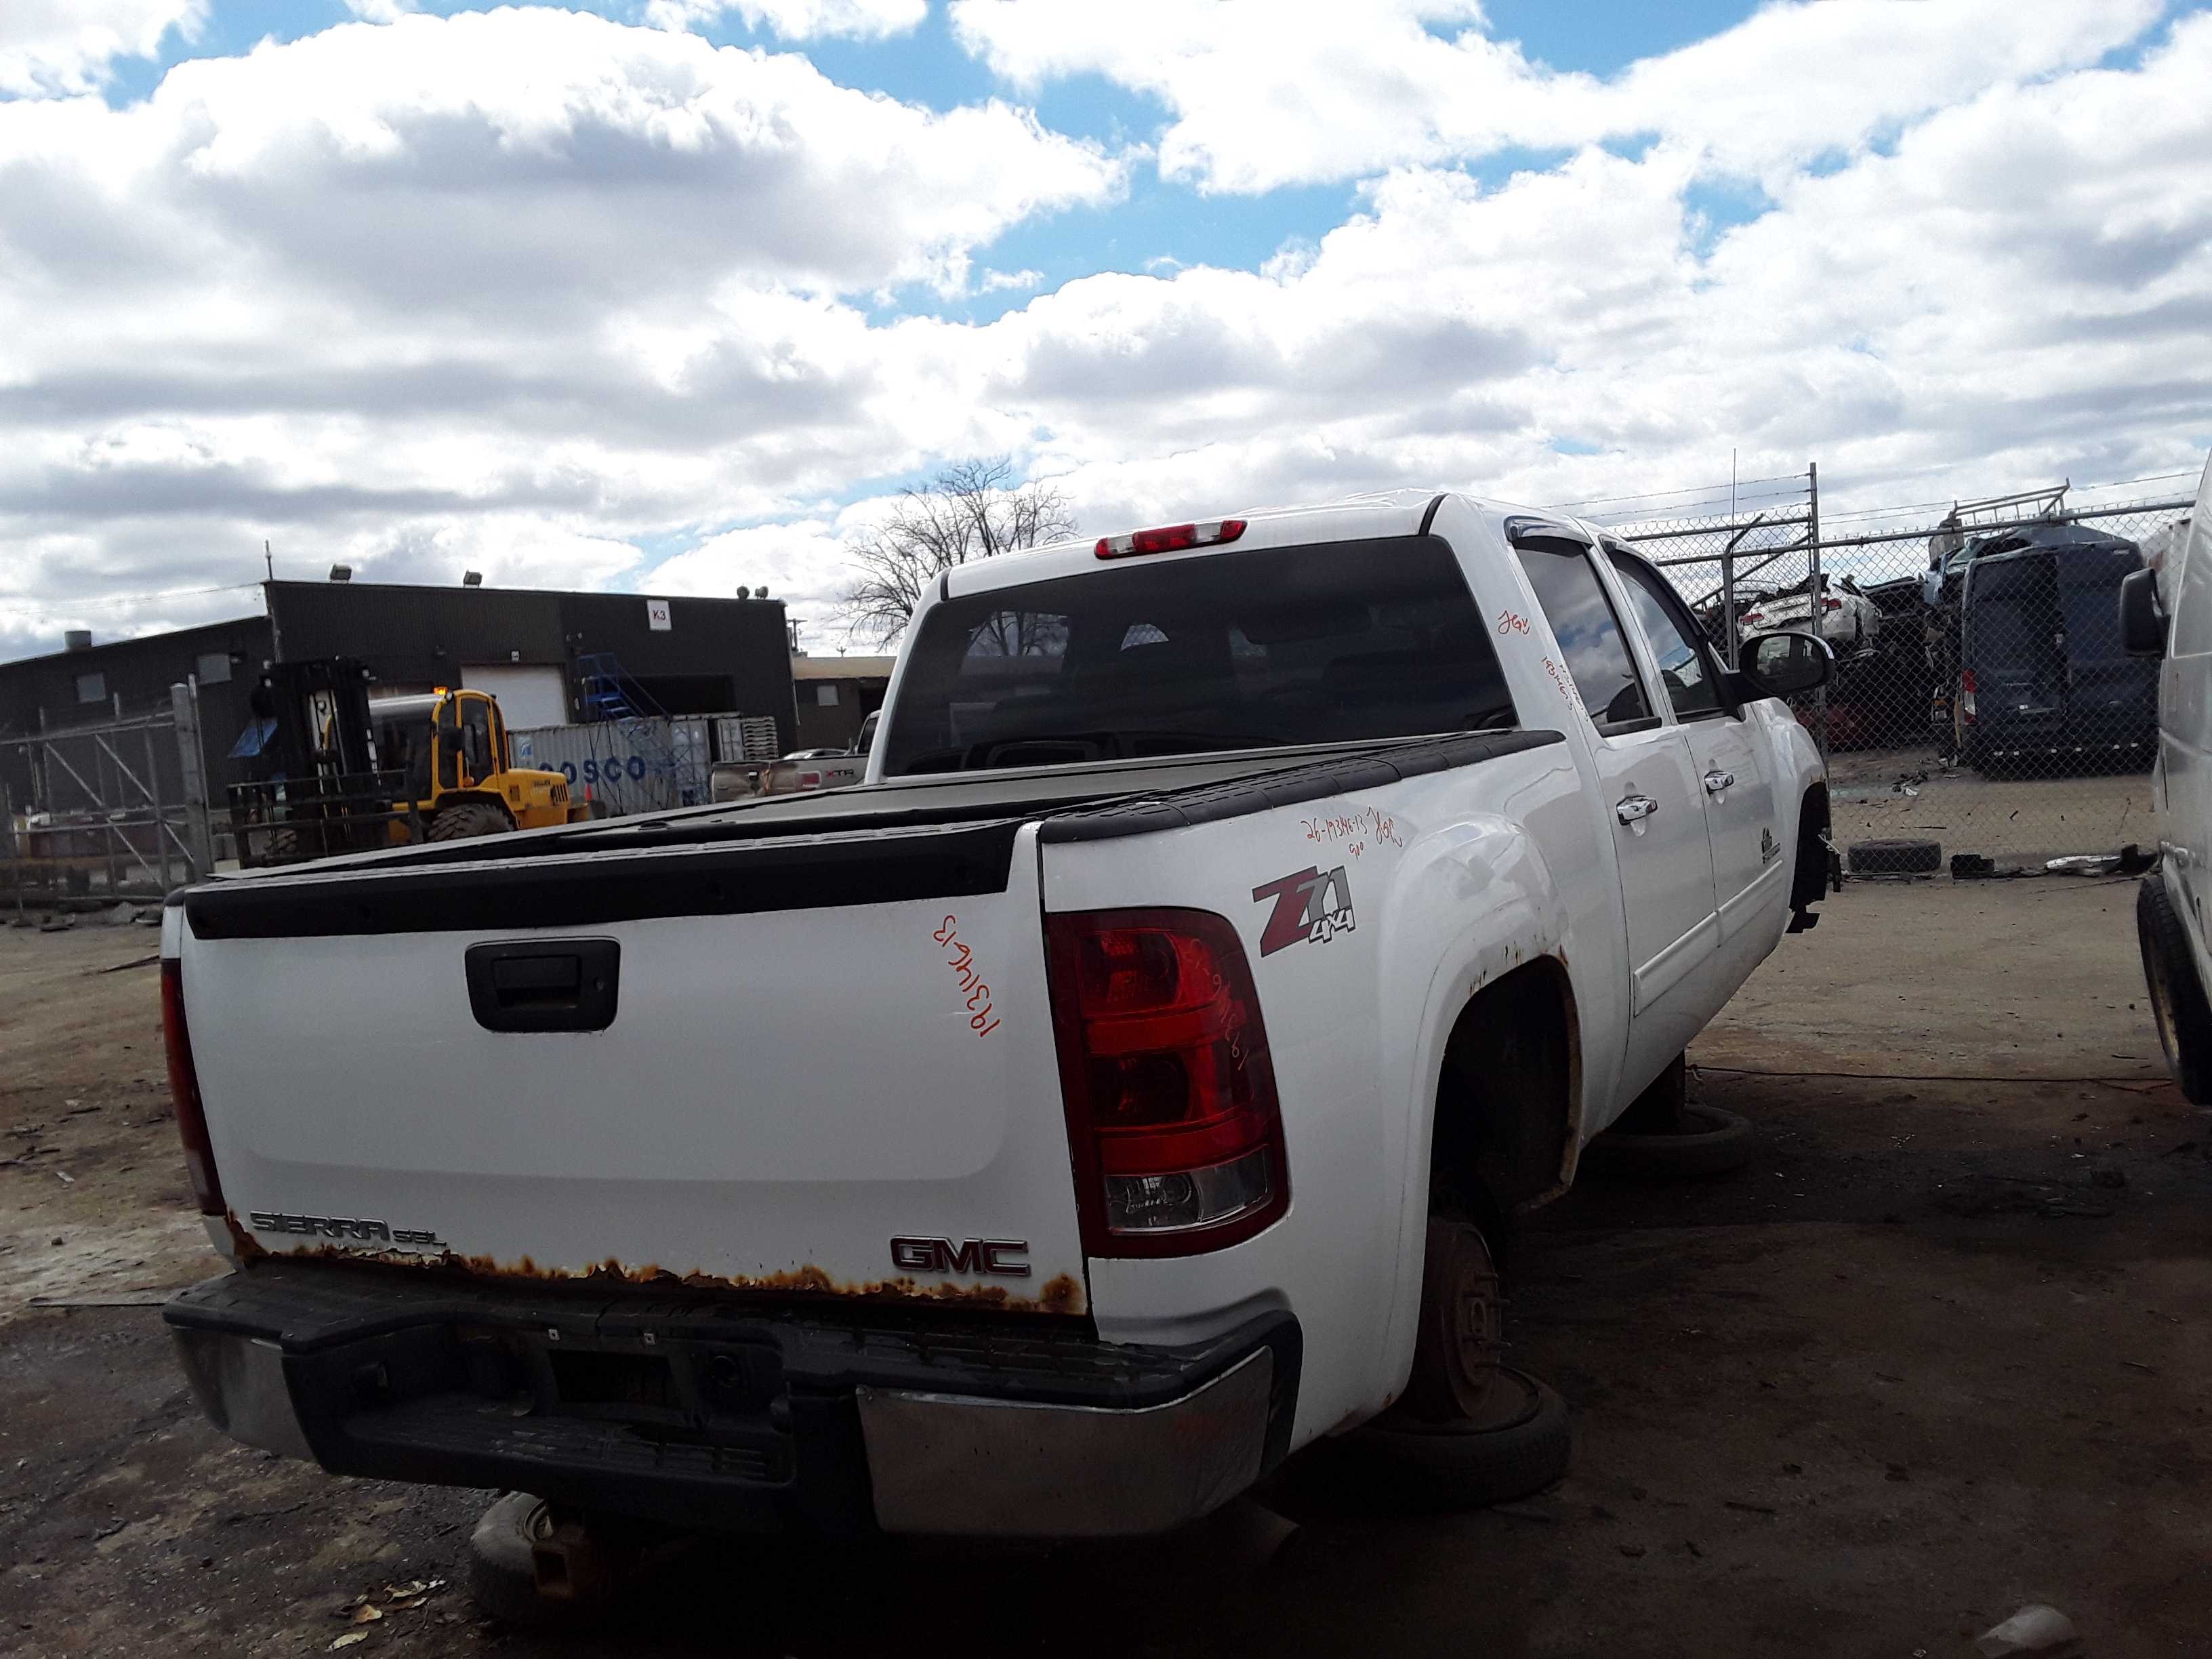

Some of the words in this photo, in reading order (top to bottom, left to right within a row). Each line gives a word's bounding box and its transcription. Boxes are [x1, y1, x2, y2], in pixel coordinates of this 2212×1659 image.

[653, 609, 666, 621] K3
[825, 769, 855, 778] XTR
[1251, 864, 1353, 958] Z71
[249, 1210, 391, 1242] SIERRA
[889, 1235, 1032, 1277] GMC
